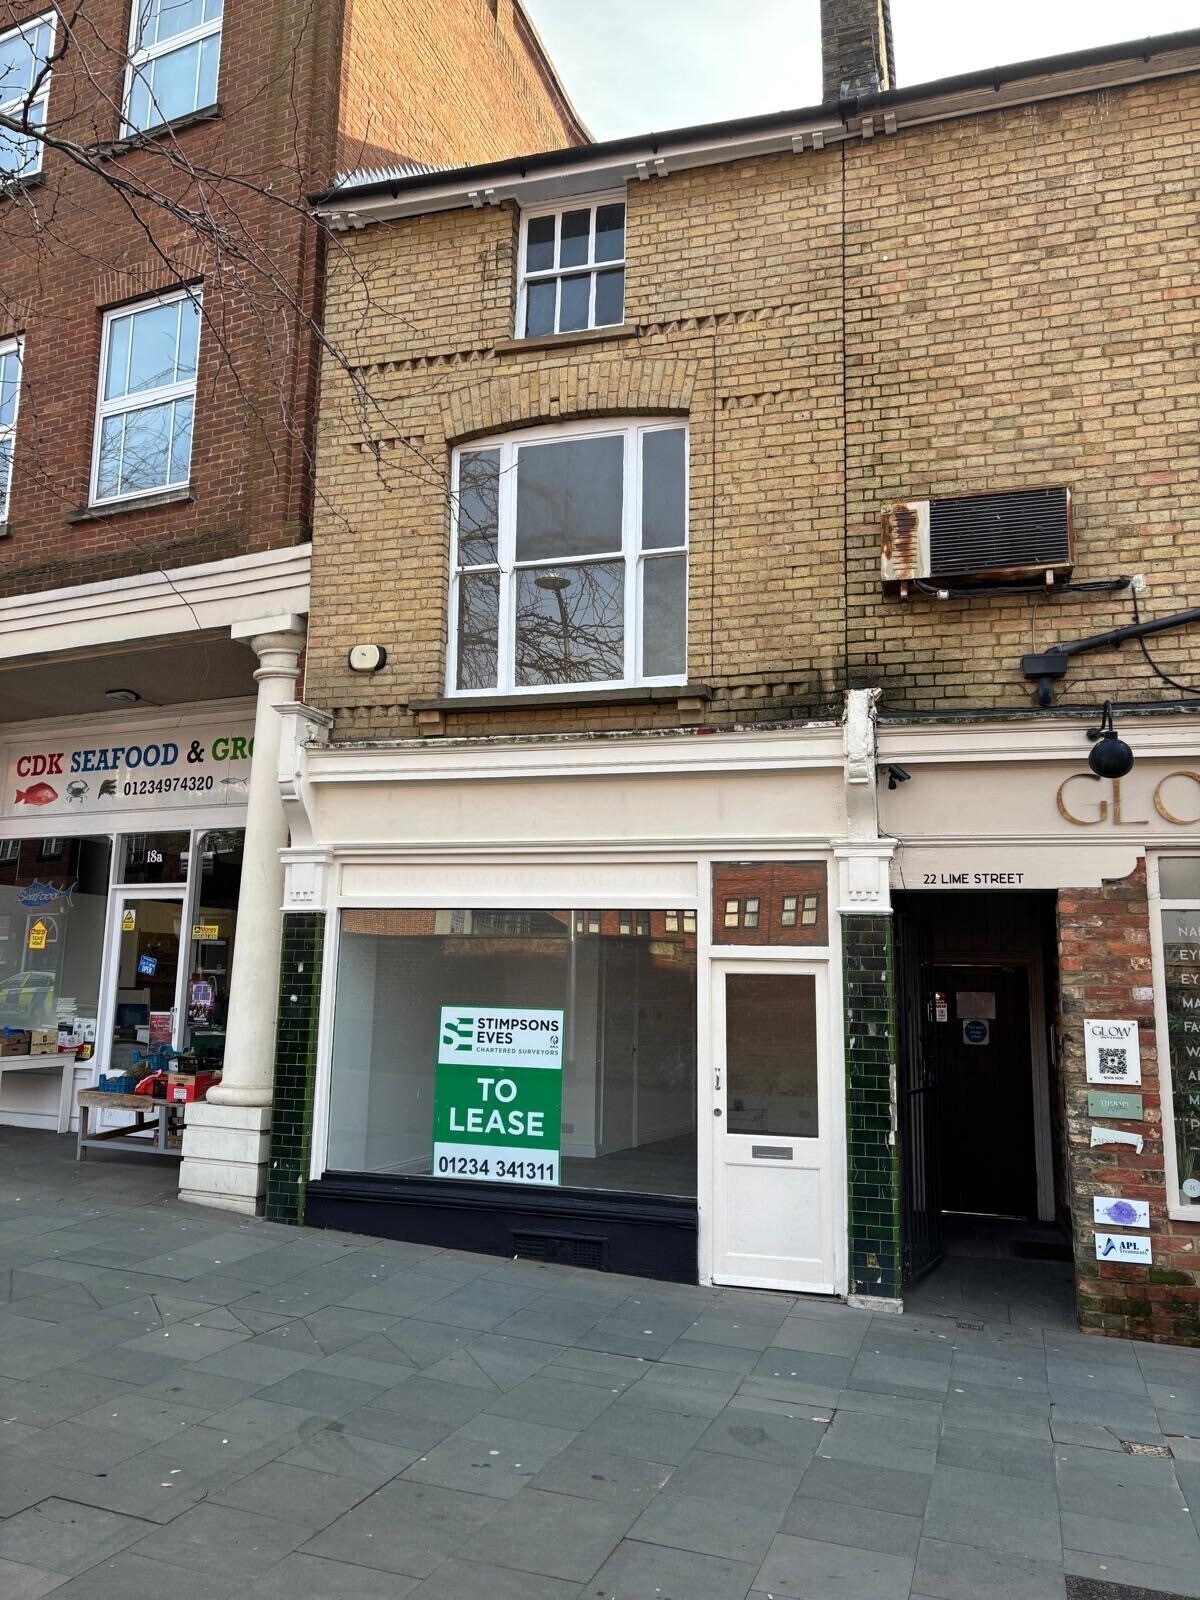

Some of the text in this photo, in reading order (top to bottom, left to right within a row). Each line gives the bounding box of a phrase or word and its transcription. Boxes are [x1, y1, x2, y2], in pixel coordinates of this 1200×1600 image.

[17, 752, 65, 777] CDK
[70, 743, 179, 773] SEAFOOD
[186, 740, 205, 764] &
[123, 775, 214, 796] 01234974320
[146, 849, 163, 863] 18a
[923, 873, 1025, 885] 22 LIME STREET
[477, 1017, 560, 1032] STIMPSONS
[1091, 1025, 1132, 1037] GLOW
[477, 1031, 513, 1044] EVES
[476, 1046, 559, 1056] CHARTERED SURVEYORS
[477, 1077, 518, 1103] TO
[449, 1107, 545, 1136] LEASE
[438, 1156, 554, 1181] 01234 341311
[1119, 1241, 1140, 1250] APL
